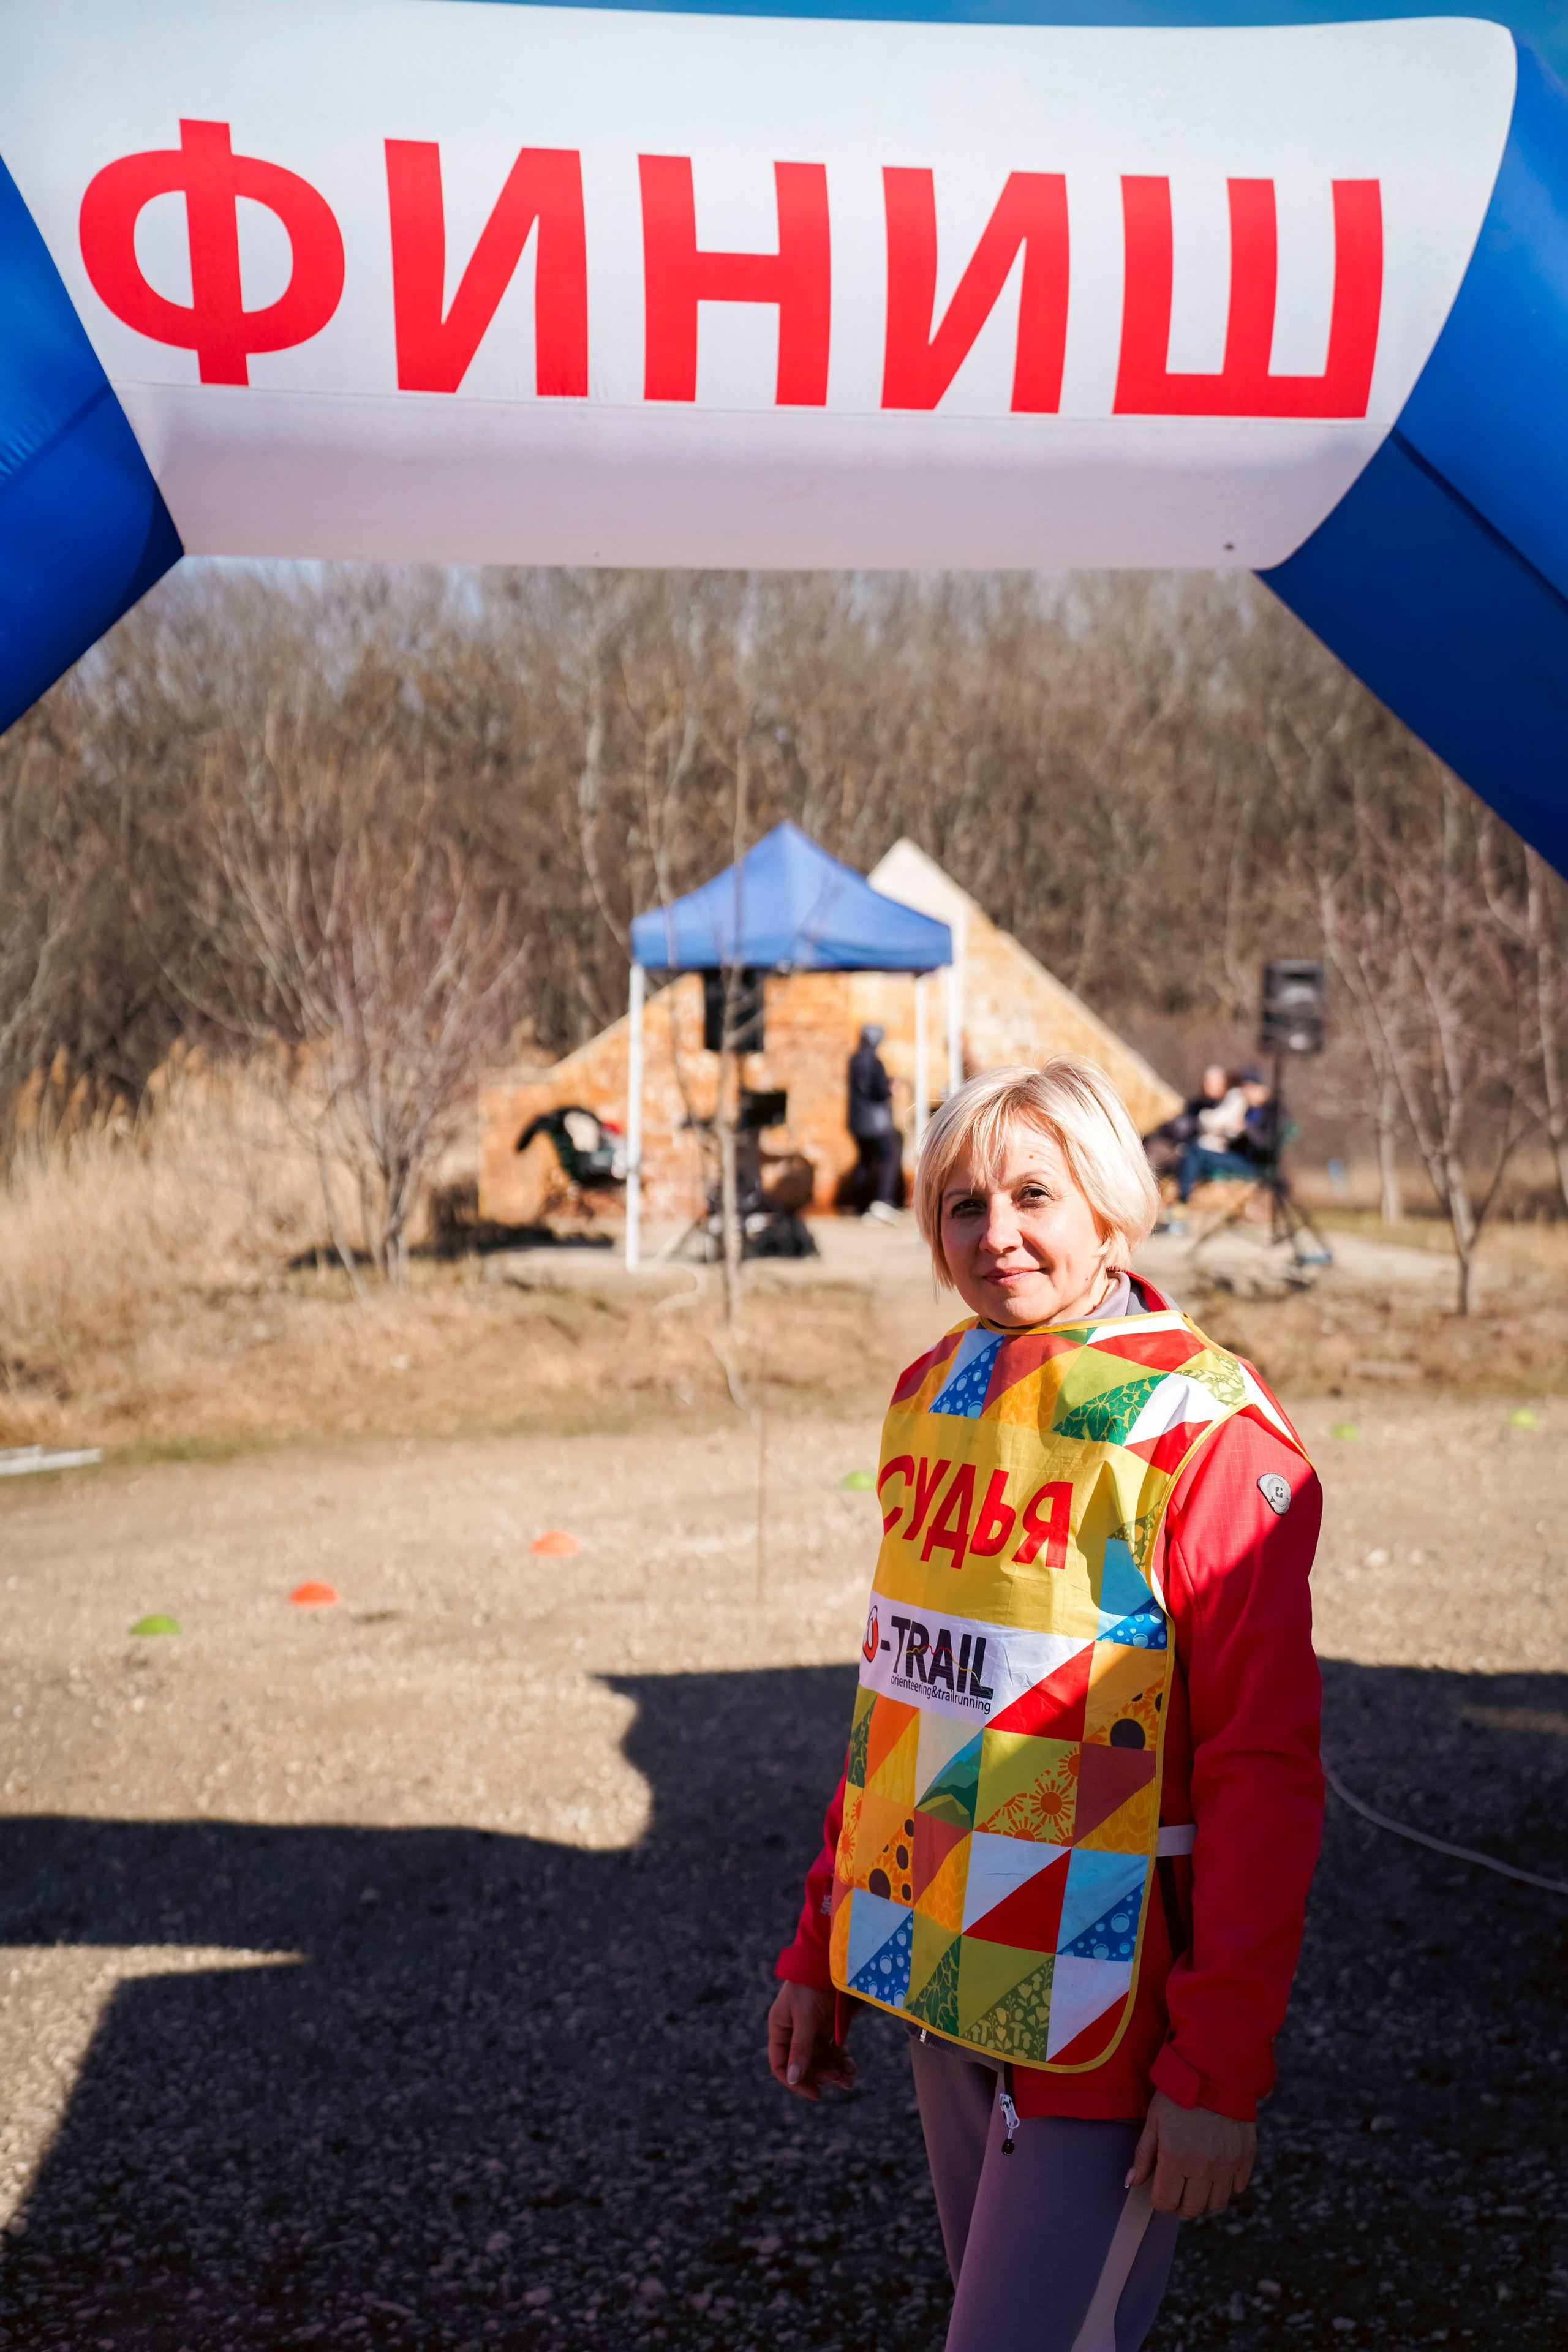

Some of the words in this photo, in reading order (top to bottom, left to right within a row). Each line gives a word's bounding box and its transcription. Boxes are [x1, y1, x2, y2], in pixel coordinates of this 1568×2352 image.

[79, 119, 1383, 418] ФИНИШ
[876, 1455, 1074, 1569] СУДЬЯ
[891, 1674, 991, 1714] orienteering&trailrunning
